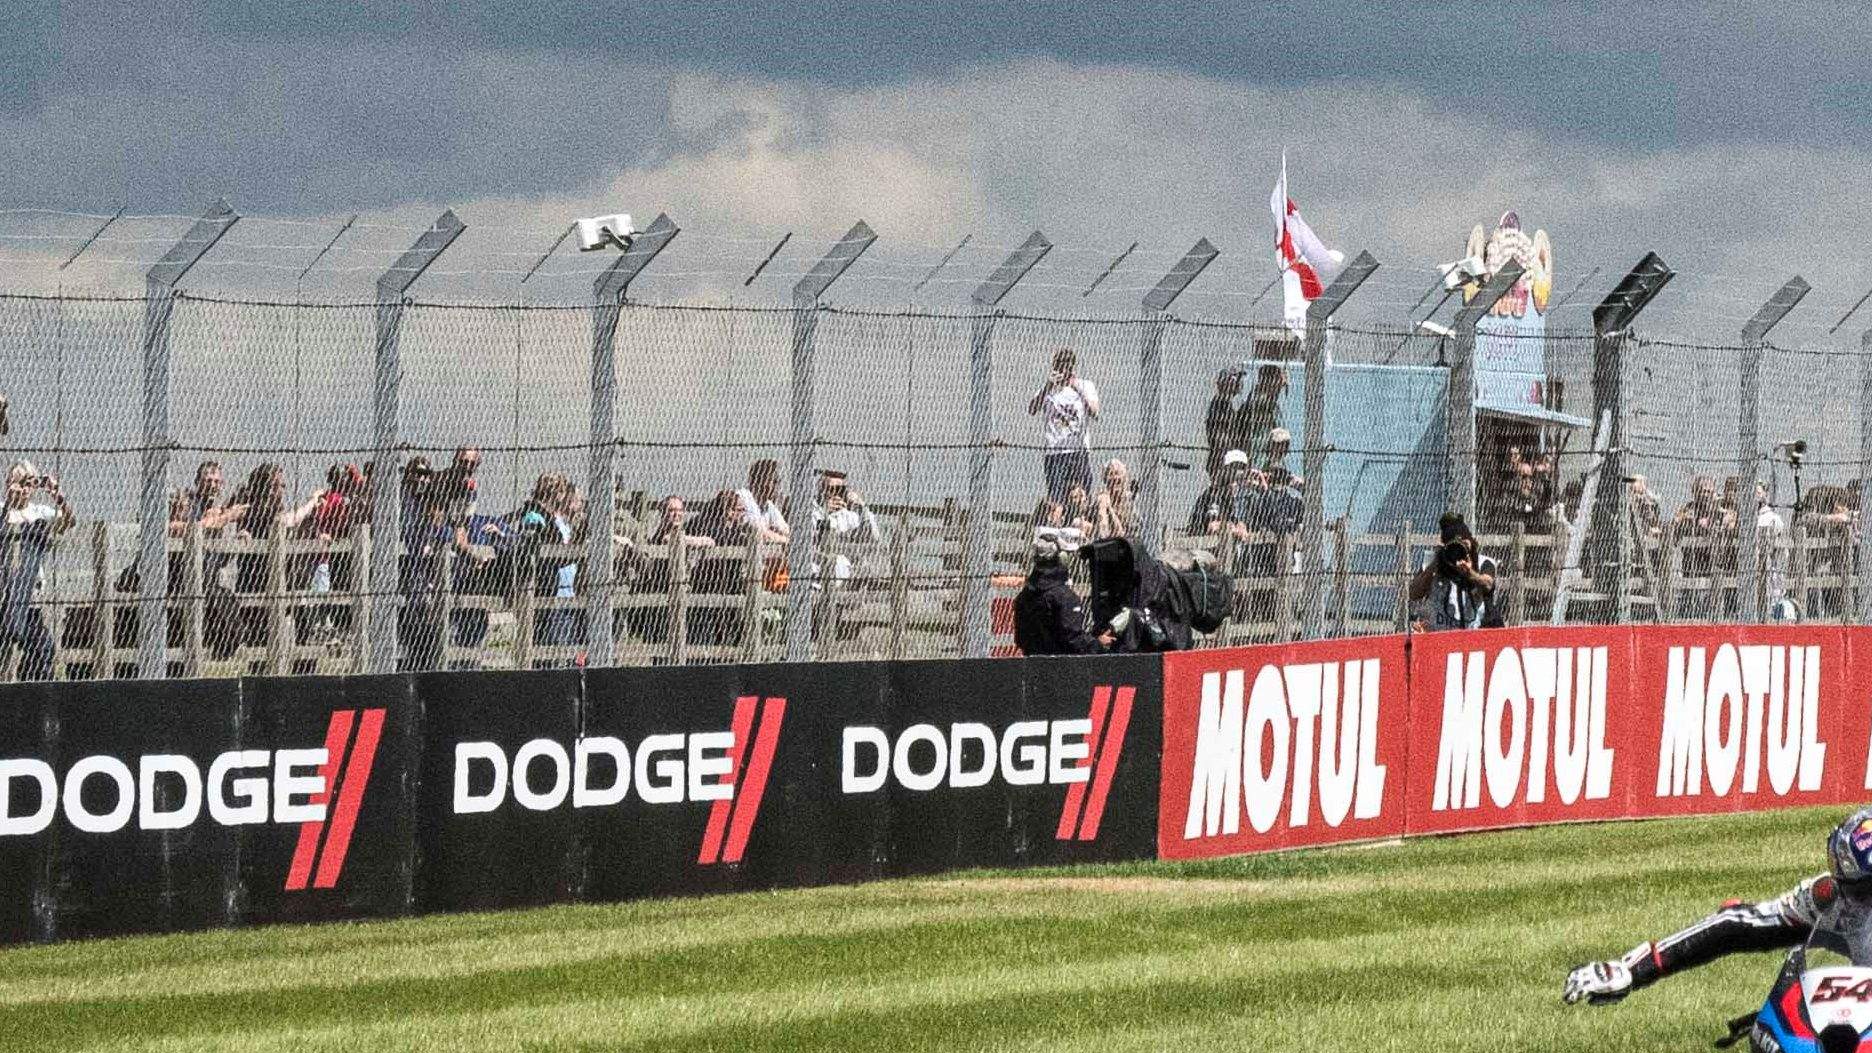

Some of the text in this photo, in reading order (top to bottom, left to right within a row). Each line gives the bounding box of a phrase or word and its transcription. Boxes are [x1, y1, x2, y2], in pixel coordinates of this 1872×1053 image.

[453, 731, 736, 814] DODGE
[841, 718, 1093, 795] DODGE
[1184, 658, 1387, 840] MOTUL
[1432, 646, 1615, 812] MOTUL
[1655, 642, 1827, 797] MOTUL
[0, 747, 329, 836] DODGE
